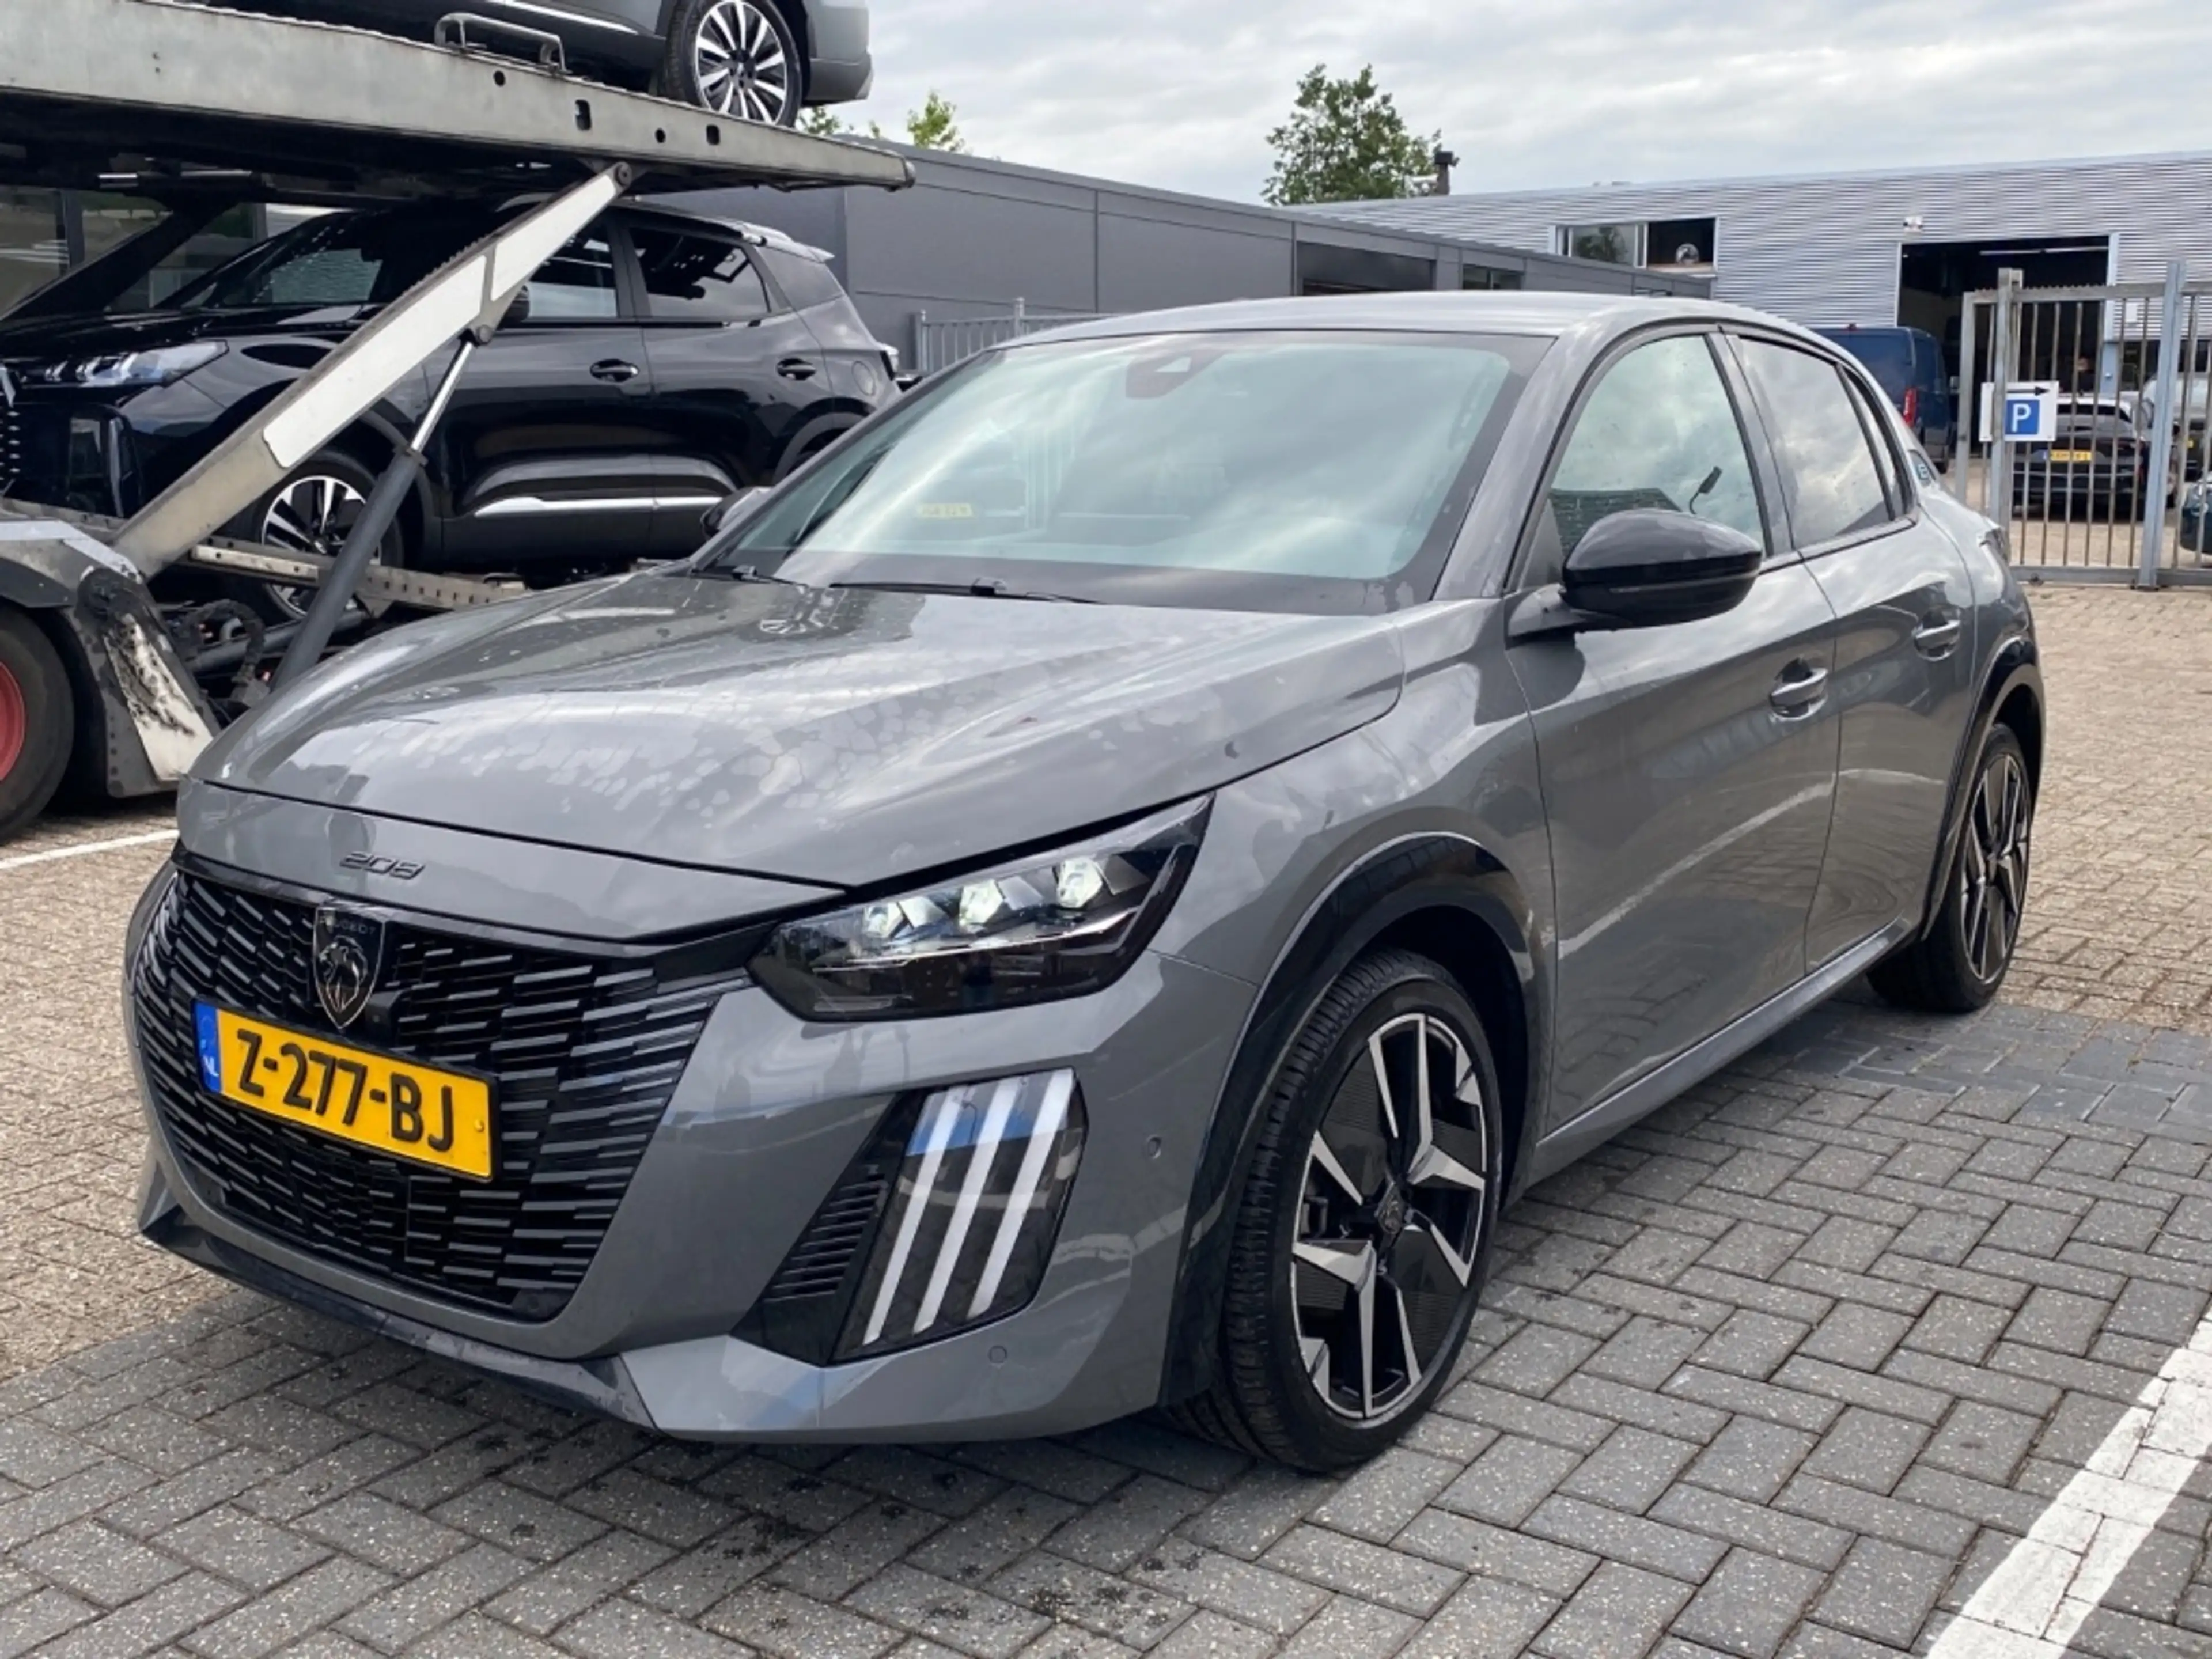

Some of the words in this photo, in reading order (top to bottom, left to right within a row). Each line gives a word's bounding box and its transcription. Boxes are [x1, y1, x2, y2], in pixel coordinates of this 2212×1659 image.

[2011, 403, 2031, 433] P
[339, 850, 426, 880] 208
[236, 1028, 455, 1152] Z-277-BJ
